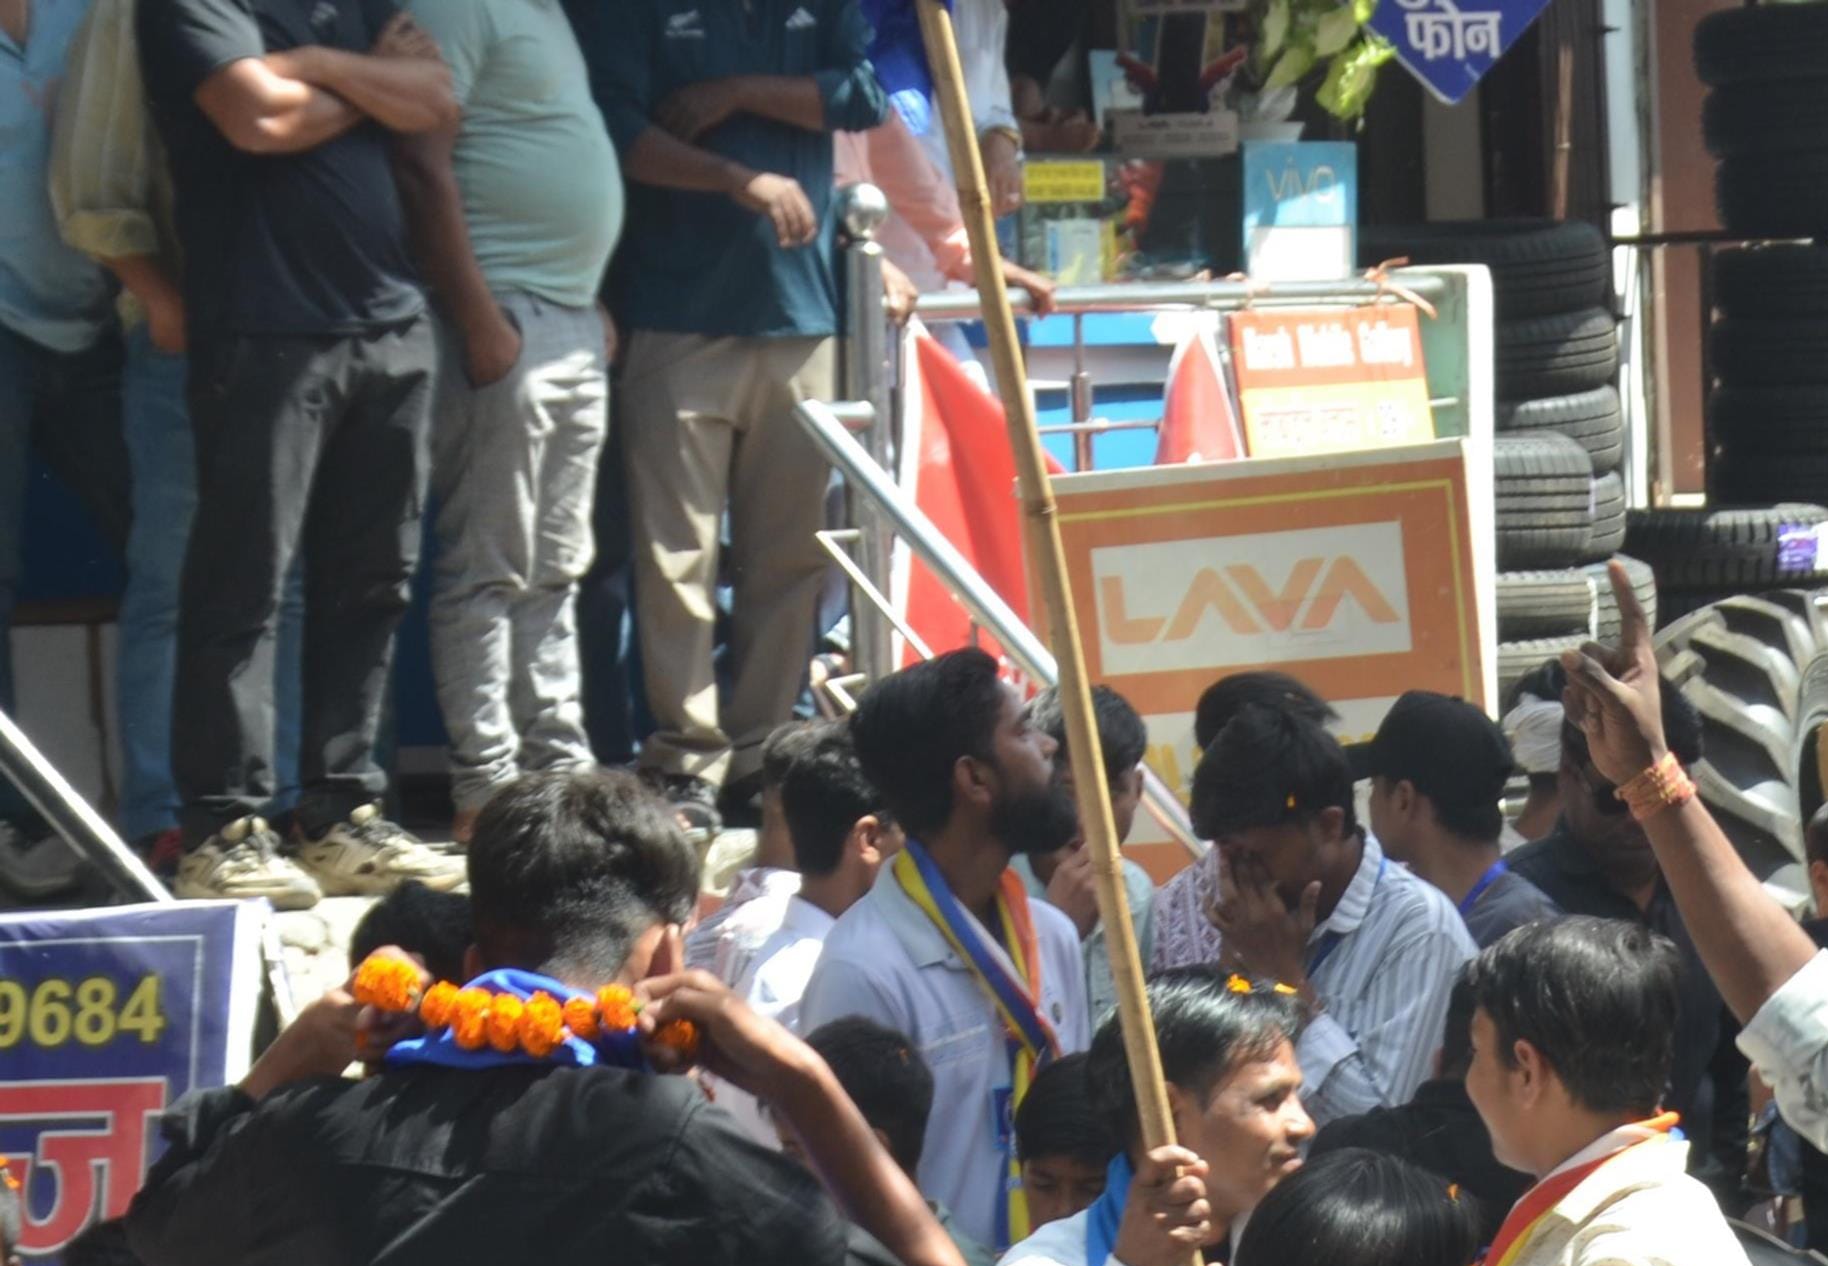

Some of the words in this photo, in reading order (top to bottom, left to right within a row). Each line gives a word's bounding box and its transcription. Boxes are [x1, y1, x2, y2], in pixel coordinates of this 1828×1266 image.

[1404, 4, 1502, 60] फोन
[1264, 155, 1336, 203] vivo
[1100, 555, 1399, 645] LAVA
[0, 975, 165, 1047] 9684
